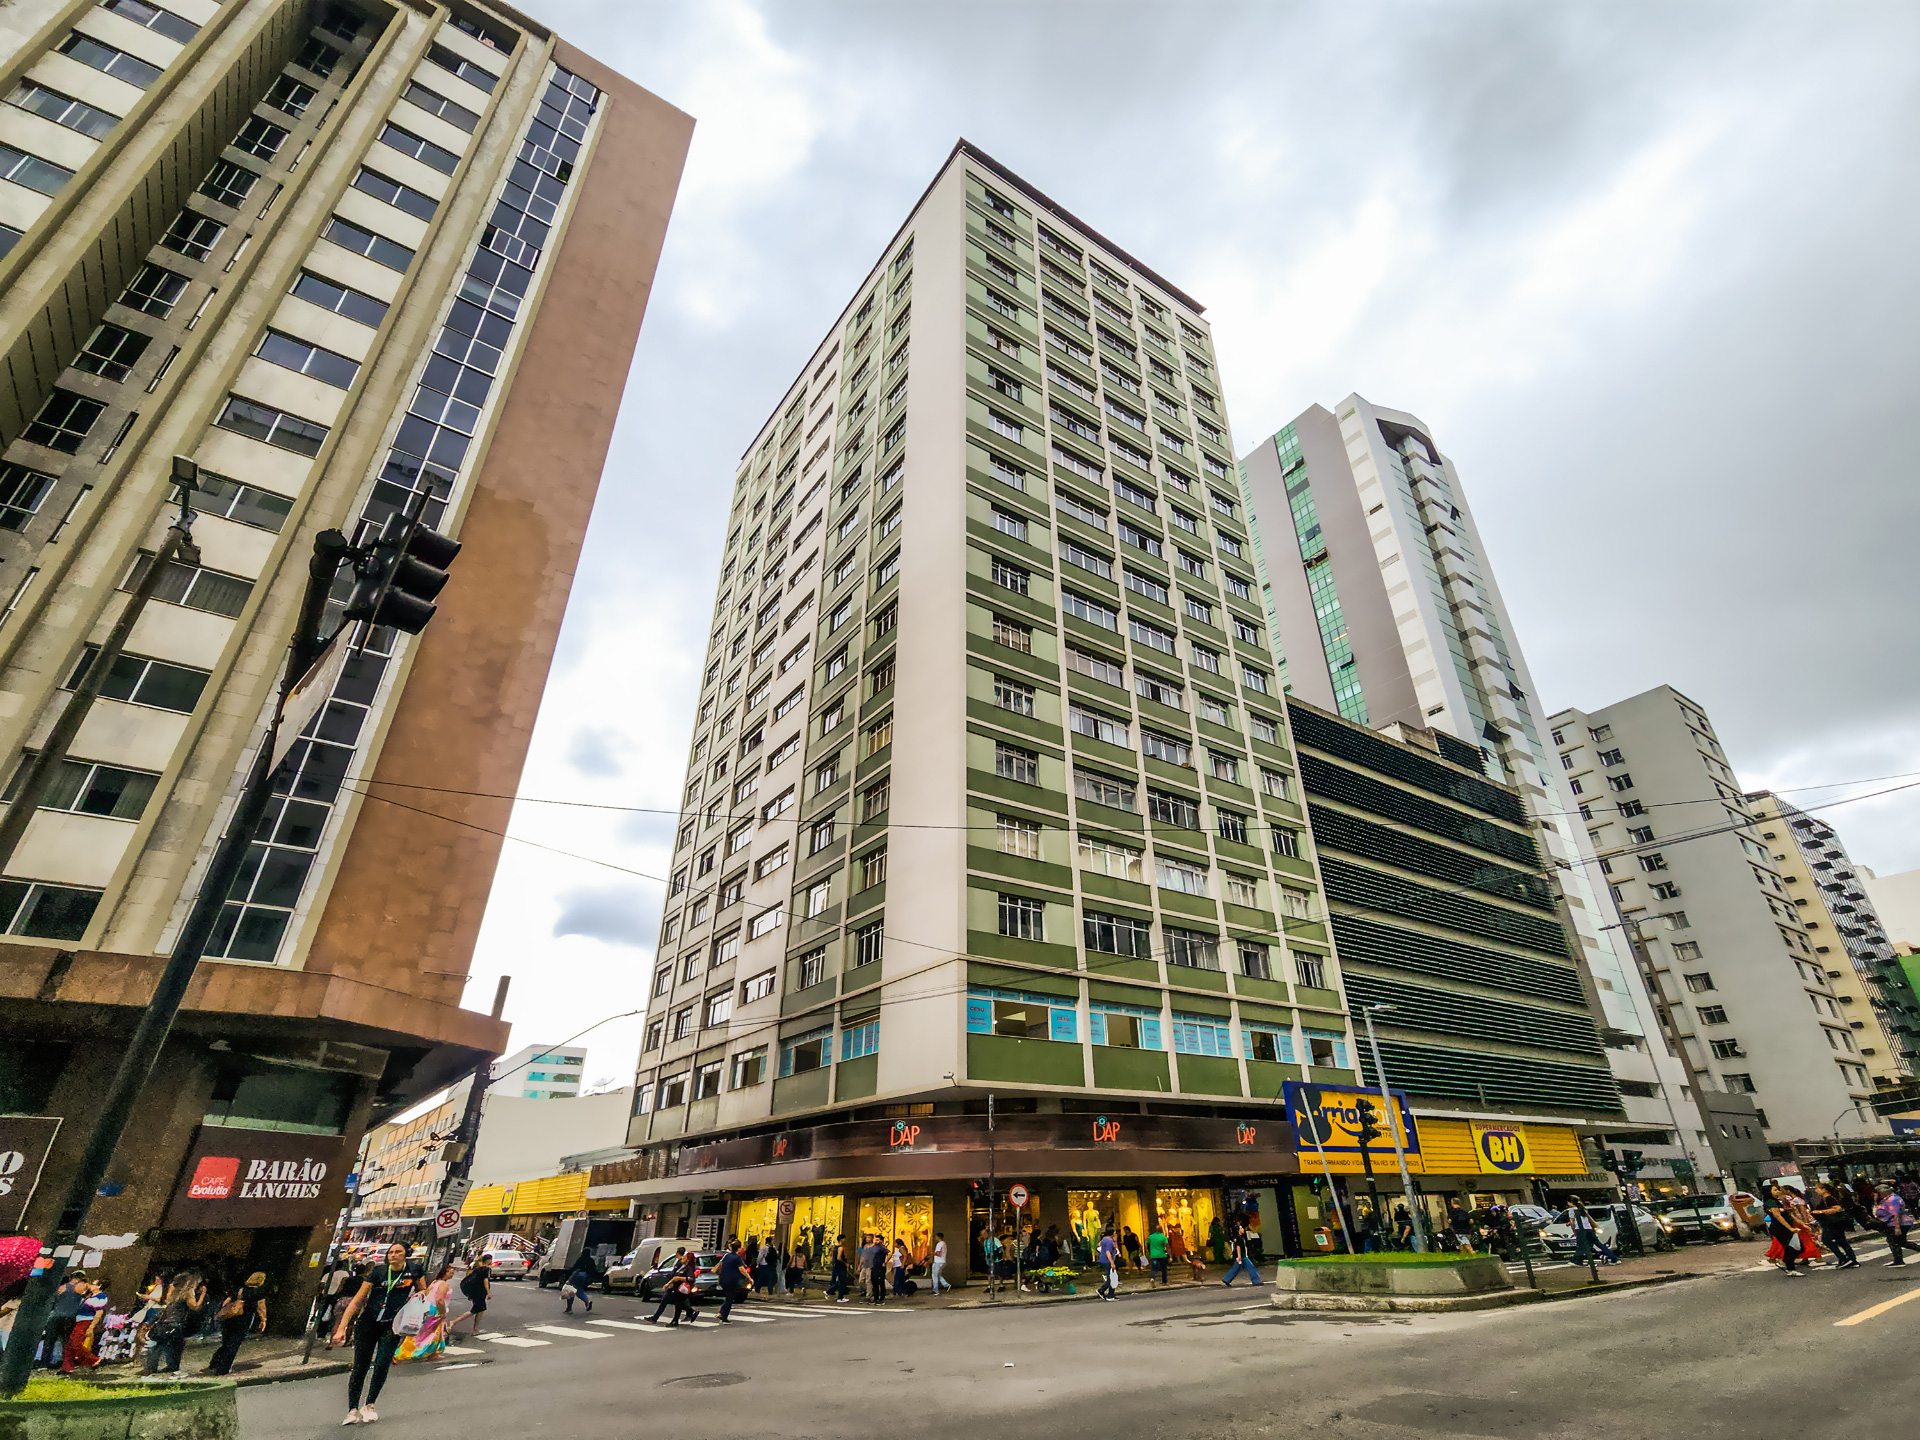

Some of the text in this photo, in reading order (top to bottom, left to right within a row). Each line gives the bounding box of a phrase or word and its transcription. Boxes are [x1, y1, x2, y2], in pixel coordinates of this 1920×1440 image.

[890, 1125, 920, 1146] DAP
[1093, 1121, 1120, 1141] DAP
[1237, 1126, 1256, 1144] DAP
[1474, 1123, 1521, 1132] SUPERMERCADOS
[1488, 1135, 1520, 1163] BH
[245, 1157, 327, 1181] BARÃO
[191, 1185, 229, 1195] Evolutto
[239, 1182, 321, 1198] LANCHES
